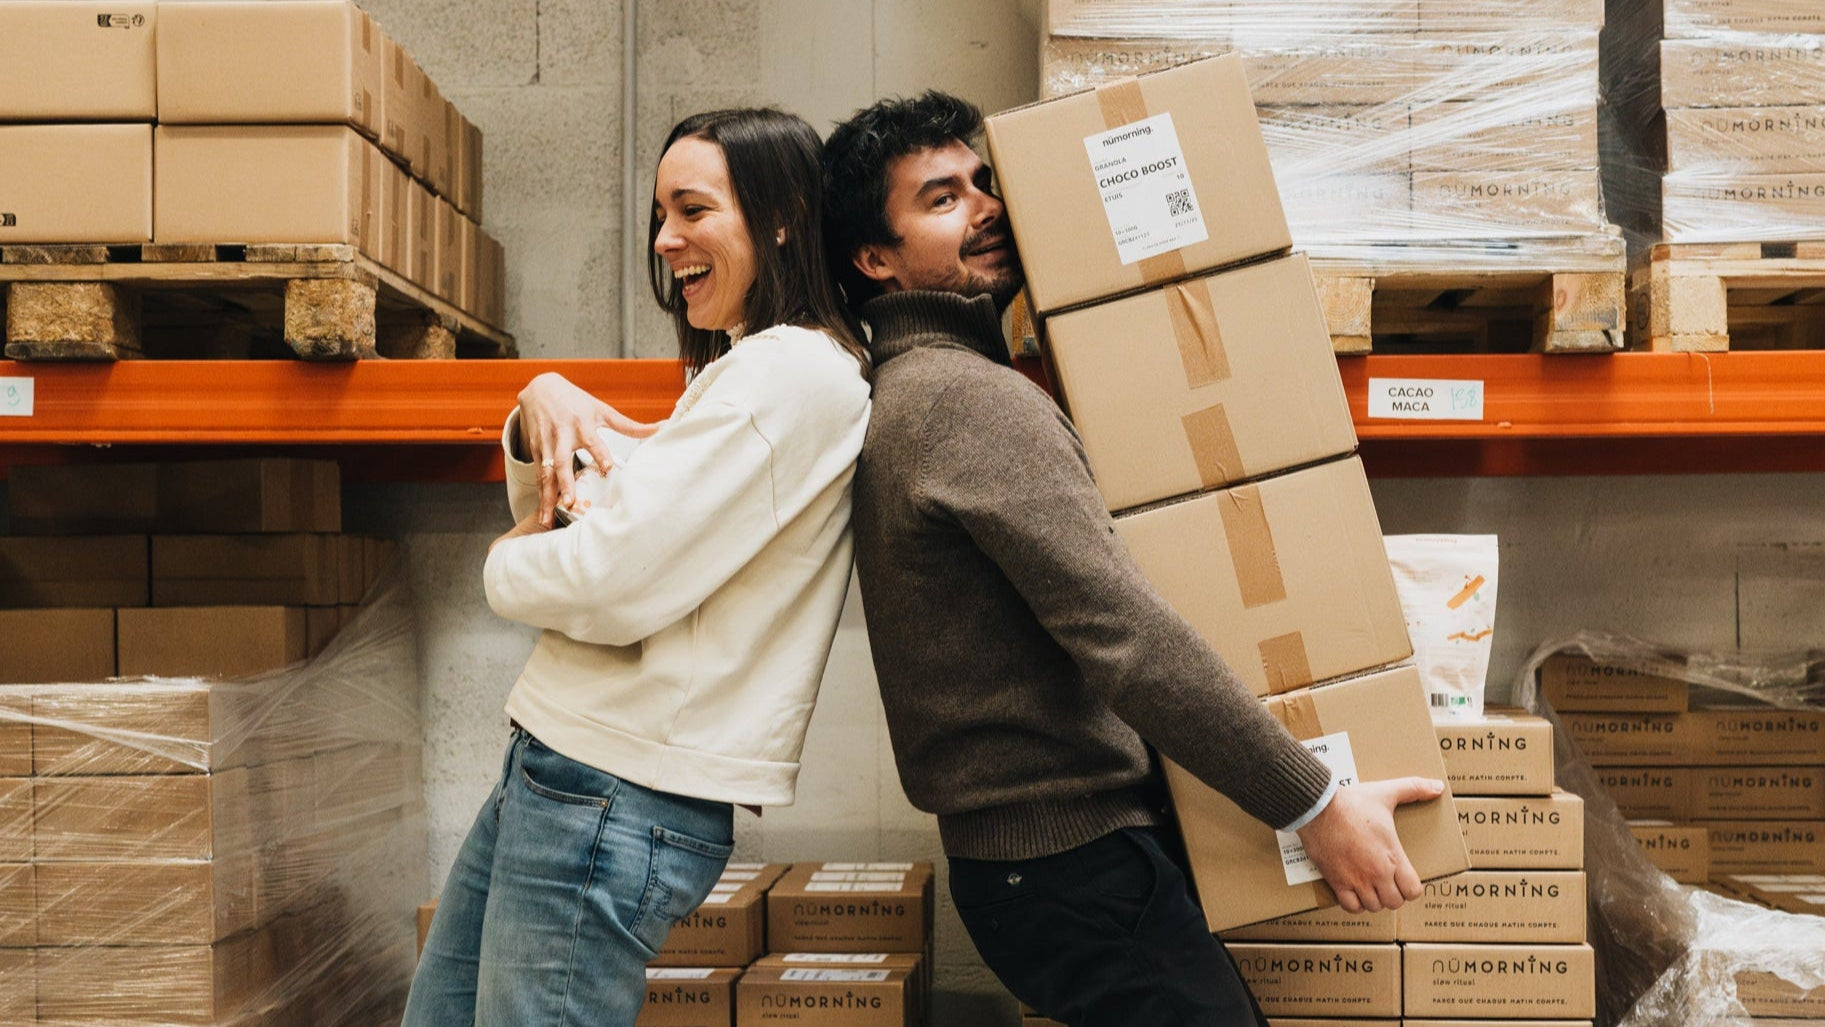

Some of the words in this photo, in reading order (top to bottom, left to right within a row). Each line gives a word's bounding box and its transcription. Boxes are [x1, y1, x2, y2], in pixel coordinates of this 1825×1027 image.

[1094, 156, 1127, 172] GRANOLA
[1099, 169, 1139, 189] CHOCO
[1141, 156, 1178, 176] BOOST
[1388, 387, 1434, 398] CACAO
[1392, 401, 1430, 412] MACA
[1440, 732, 1527, 751] ORNING
[1600, 772, 1673, 787] ORNING
[1458, 806, 1561, 825] MORNING
[1453, 978, 1475, 986] ritual
[648, 987, 711, 1004] RNING
